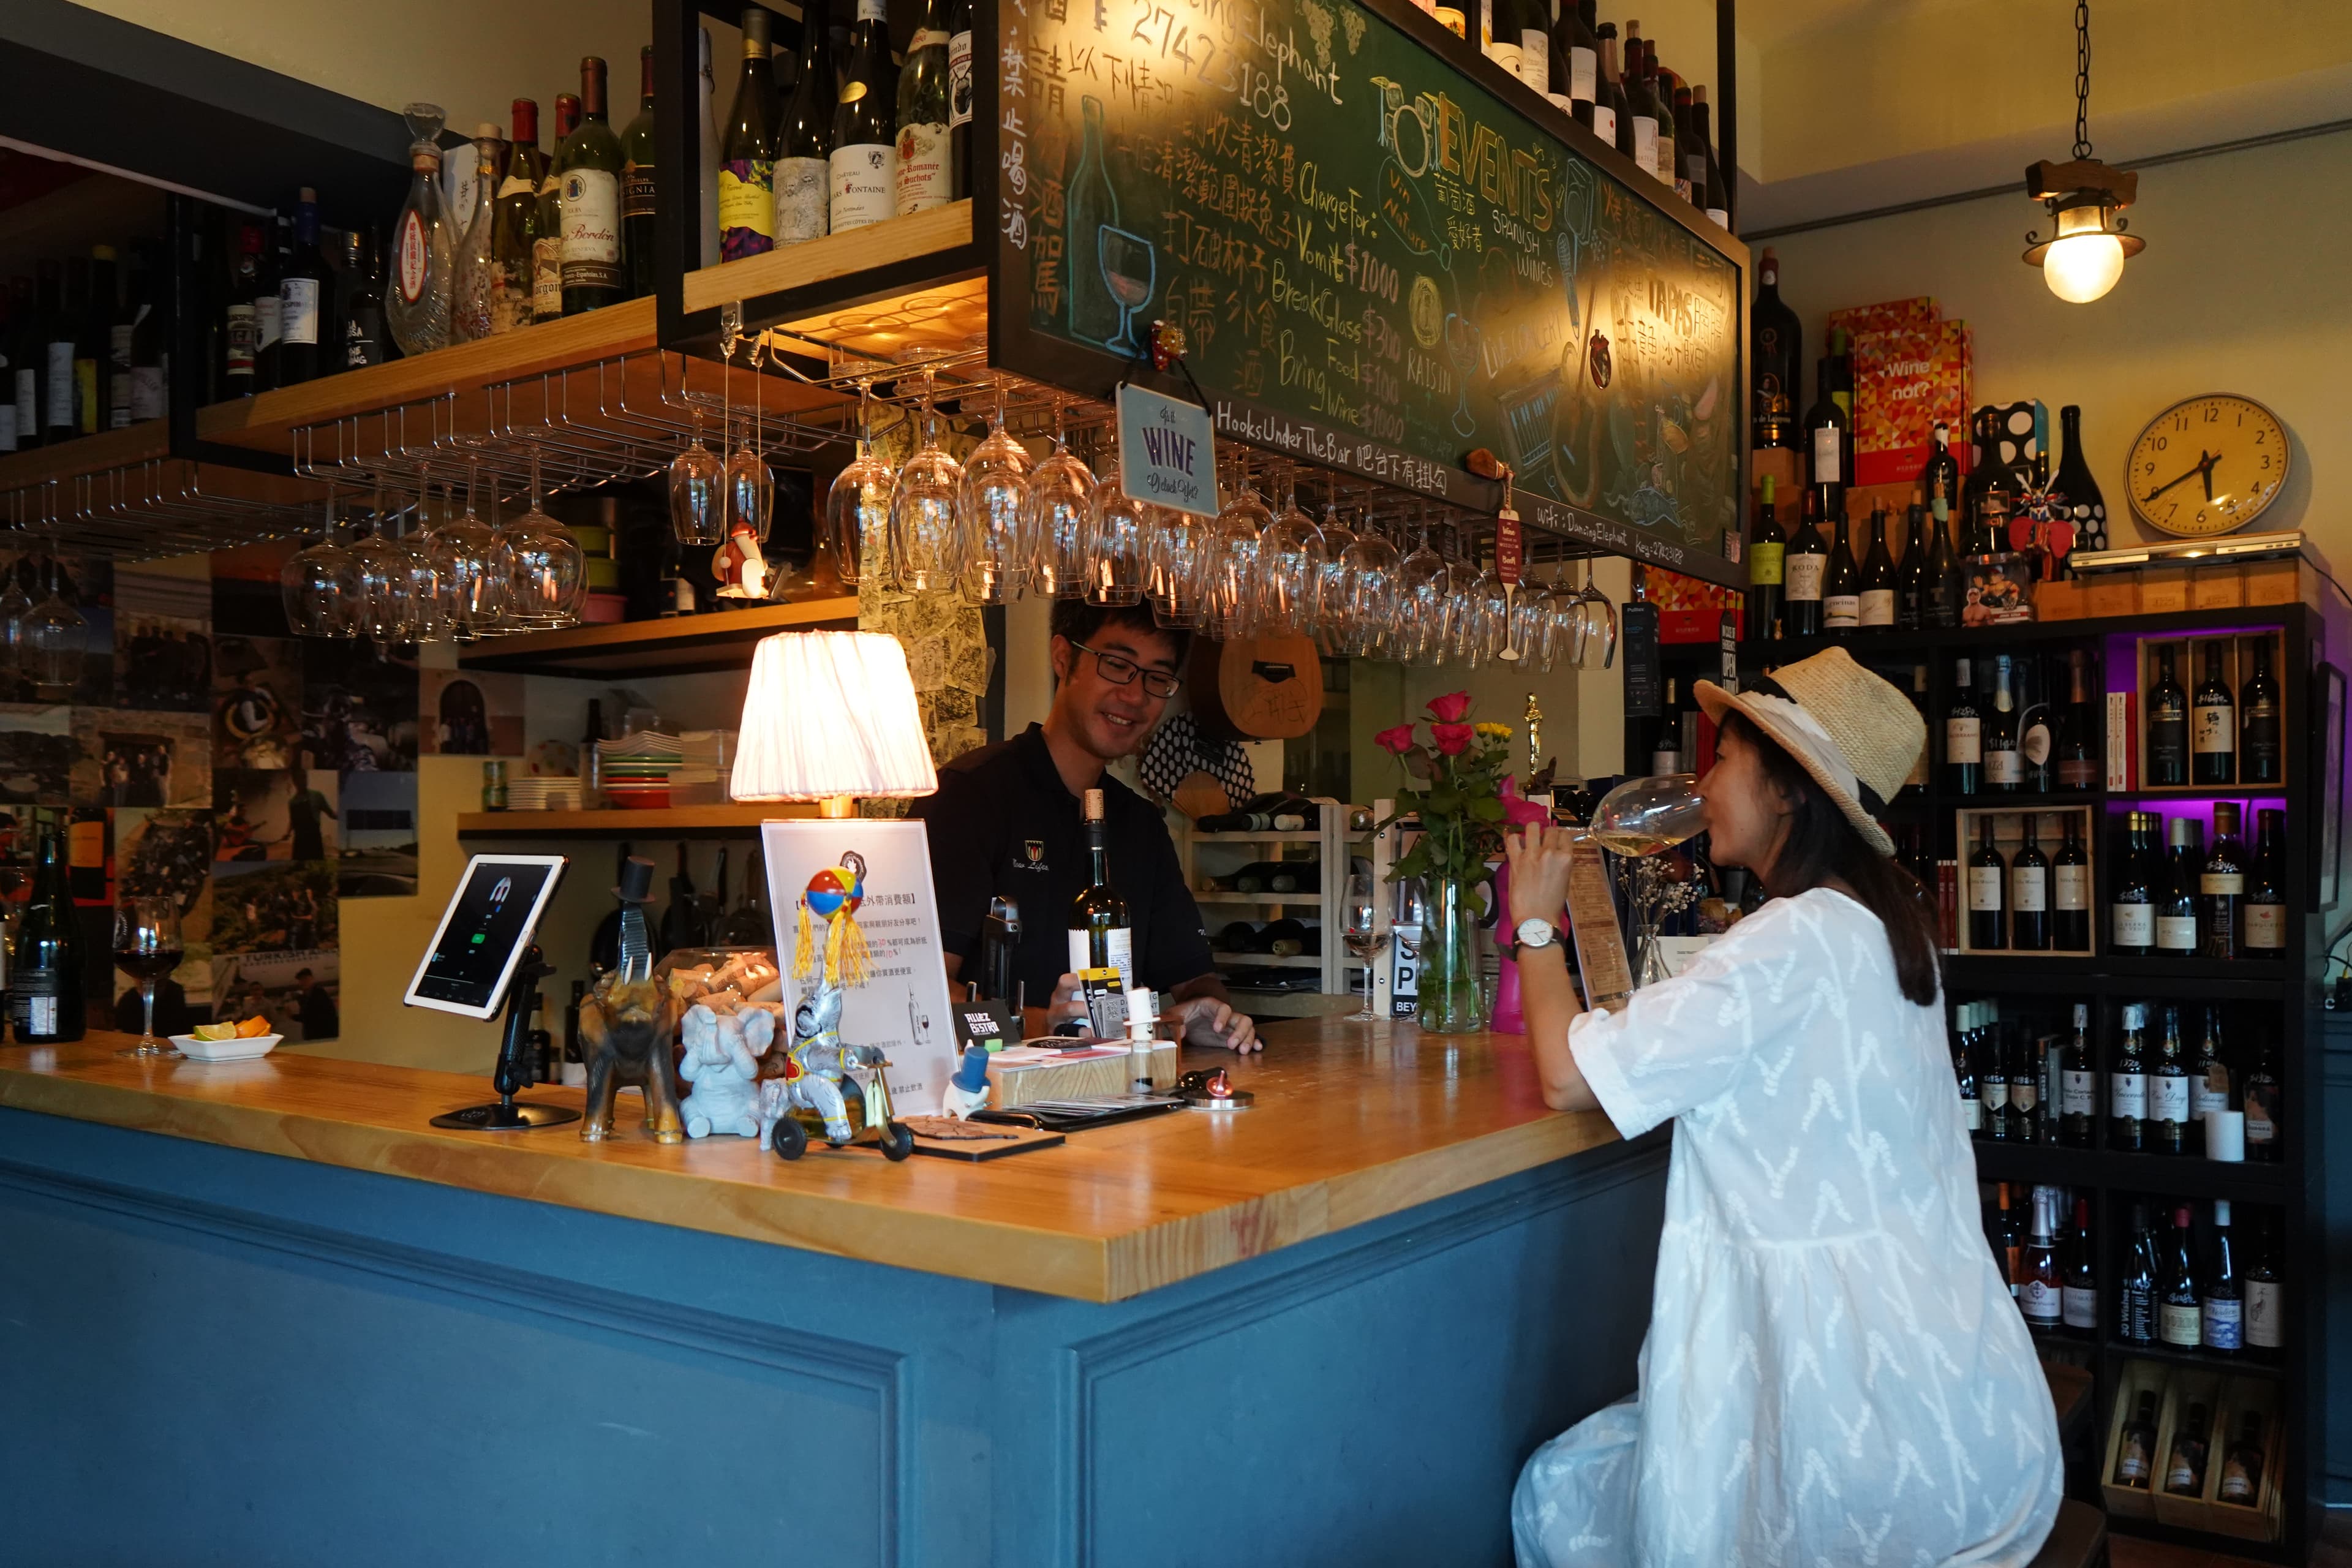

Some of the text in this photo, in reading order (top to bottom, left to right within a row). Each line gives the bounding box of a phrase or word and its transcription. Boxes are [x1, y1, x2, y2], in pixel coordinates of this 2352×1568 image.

[845, 182, 886, 195] FONTAINE
[1300, 161, 1348, 232] Charge
[1433, 172, 1476, 216] 葡萄酒
[570, 224, 615, 242] Bordón
[1446, 217, 1483, 254] 愛好者
[1297, 215, 1400, 304] Vomit $1000
[1517, 255, 1555, 288] WINES
[535, 282, 562, 296] orgon
[1272, 258, 1402, 363] Break Glass $300
[1649, 279, 1693, 339] TAPAS
[1280, 328, 1400, 412] Bring Food $100
[1407, 346, 1452, 397] RAISIN
[1887, 360, 1931, 378] Wine
[1891, 381, 1931, 401] not?
[1327, 390, 1360, 427] Wine
[1360, 399, 1404, 444] $1000
[2203, 407, 2220, 423] 12
[2237, 413, 2242, 427] 1
[1216, 400, 1352, 465] Hooks Under The Bar
[2175, 418, 2188, 432] 11
[2150, 436, 2168, 451] 10
[2255, 430, 2265, 445] 2
[1142, 427, 1196, 477] WINE
[2145, 462, 2155, 476] 9
[2260, 456, 2271, 470] 3
[2250, 481, 2261, 495] 4
[2168, 503, 2179, 517] 7
[2196, 509, 2206, 523] 6
[2226, 500, 2236, 516] 5
[964, 1012, 991, 1023] ALLEZ
[2120, 1323, 2130, 1337] 30
